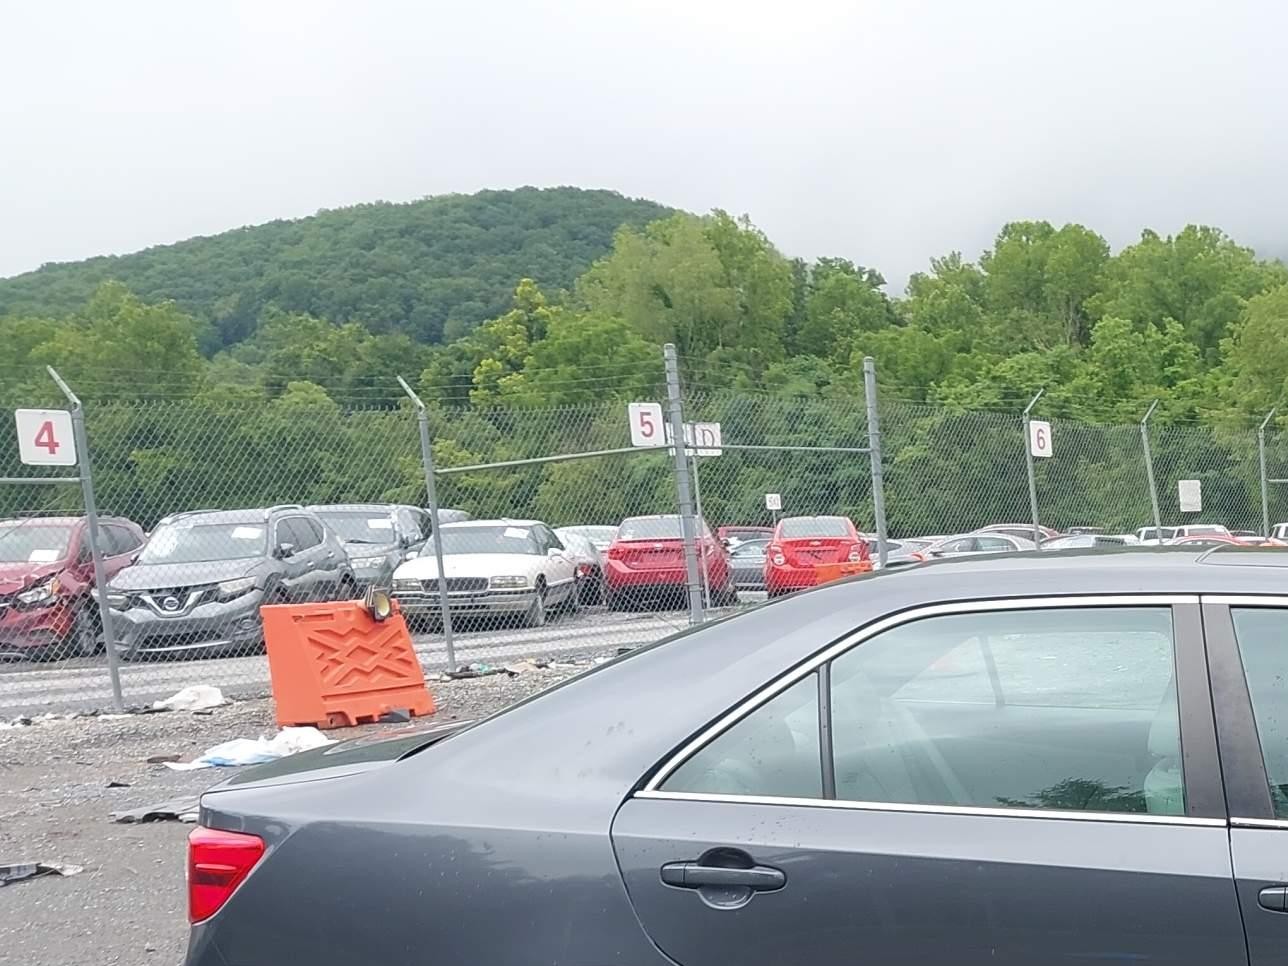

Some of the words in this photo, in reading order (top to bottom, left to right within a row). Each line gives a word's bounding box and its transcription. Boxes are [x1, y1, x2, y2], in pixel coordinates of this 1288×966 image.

[34, 421, 60, 455] 4
[639, 411, 654, 438] 5
[1036, 428, 1046, 450] 6
